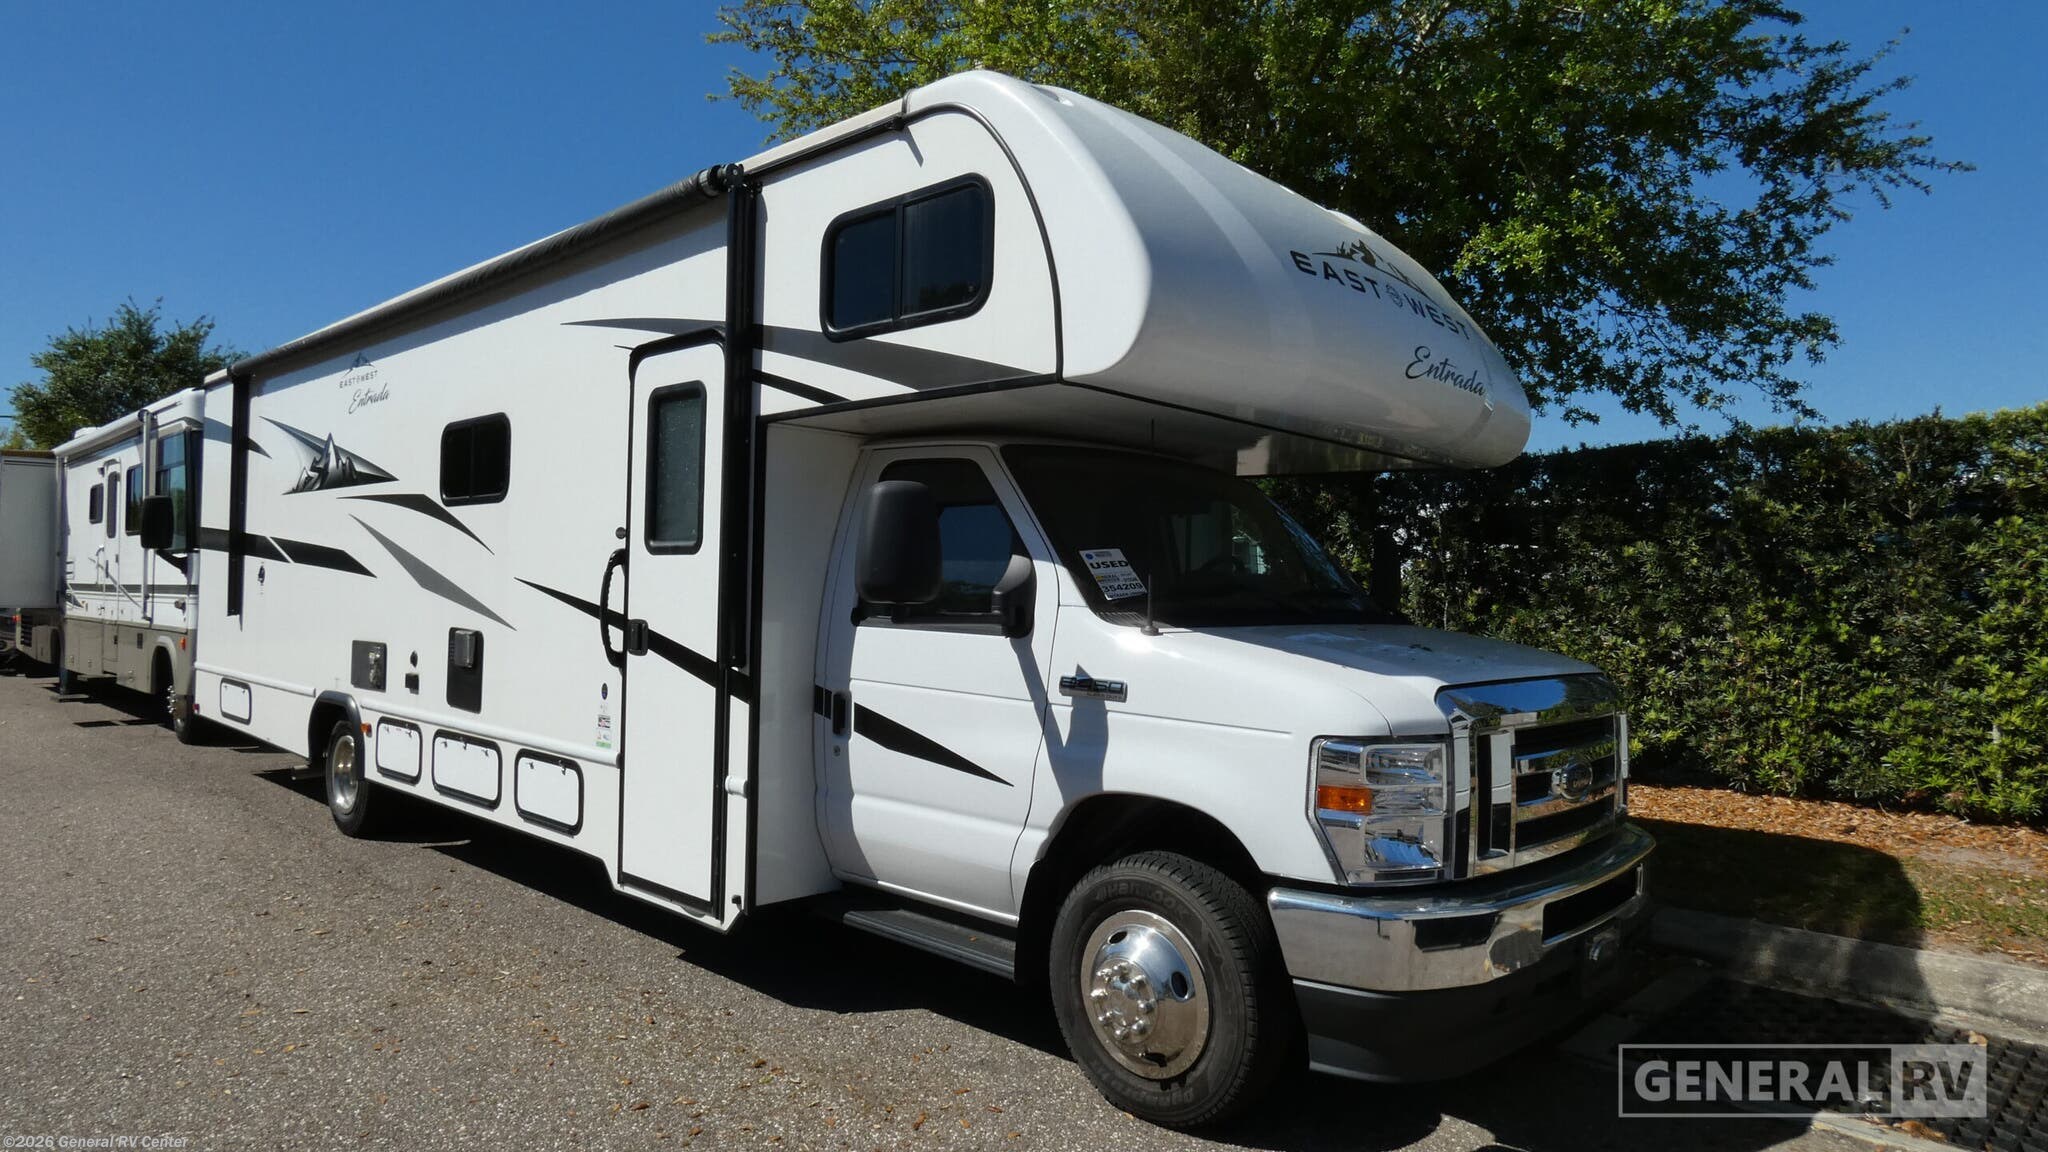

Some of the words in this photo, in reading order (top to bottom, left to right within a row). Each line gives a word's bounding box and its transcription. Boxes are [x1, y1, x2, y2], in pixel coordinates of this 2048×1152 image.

[1290, 250, 1381, 299] EAST
[1404, 293, 1470, 341] WEST
[1405, 345, 1486, 397] Entrada
[348, 382, 389, 415] Entrada
[1089, 560, 1129, 570] USED
